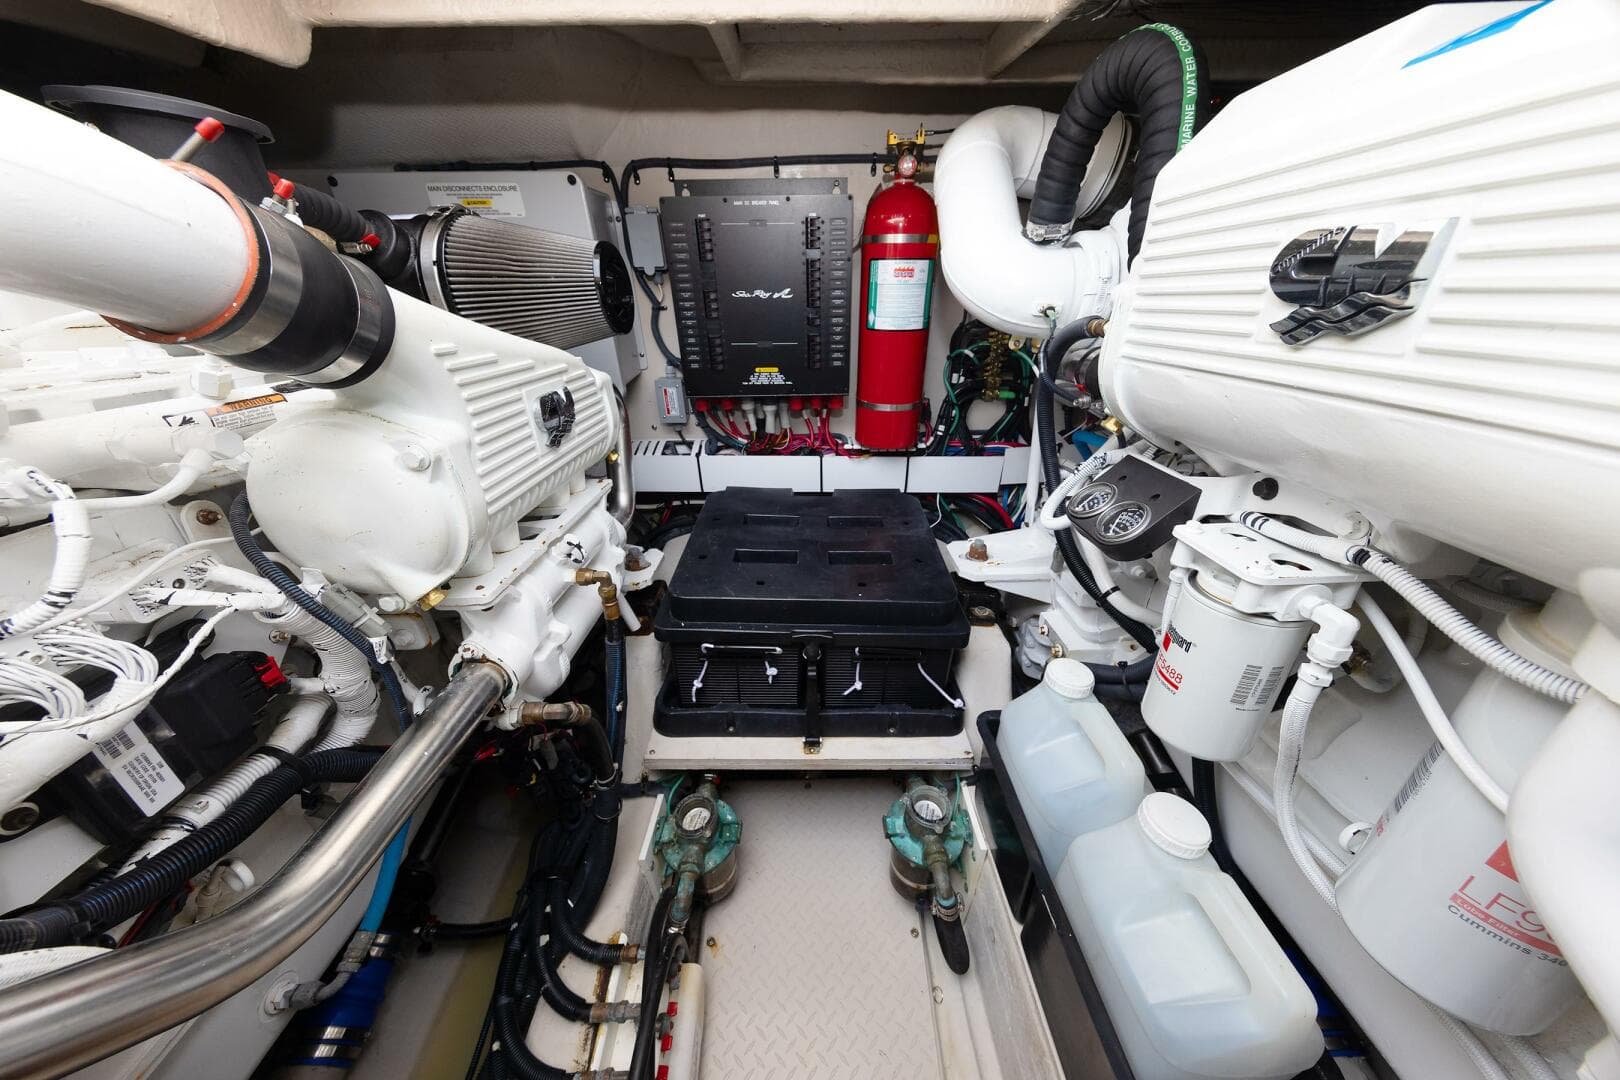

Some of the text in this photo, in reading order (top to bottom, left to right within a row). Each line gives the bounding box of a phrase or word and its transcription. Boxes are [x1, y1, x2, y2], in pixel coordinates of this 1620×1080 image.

[1185, 56, 1197, 97] WATER
[230, 397, 273, 411] WARNING
[1447, 904, 1533, 955] Cummins
